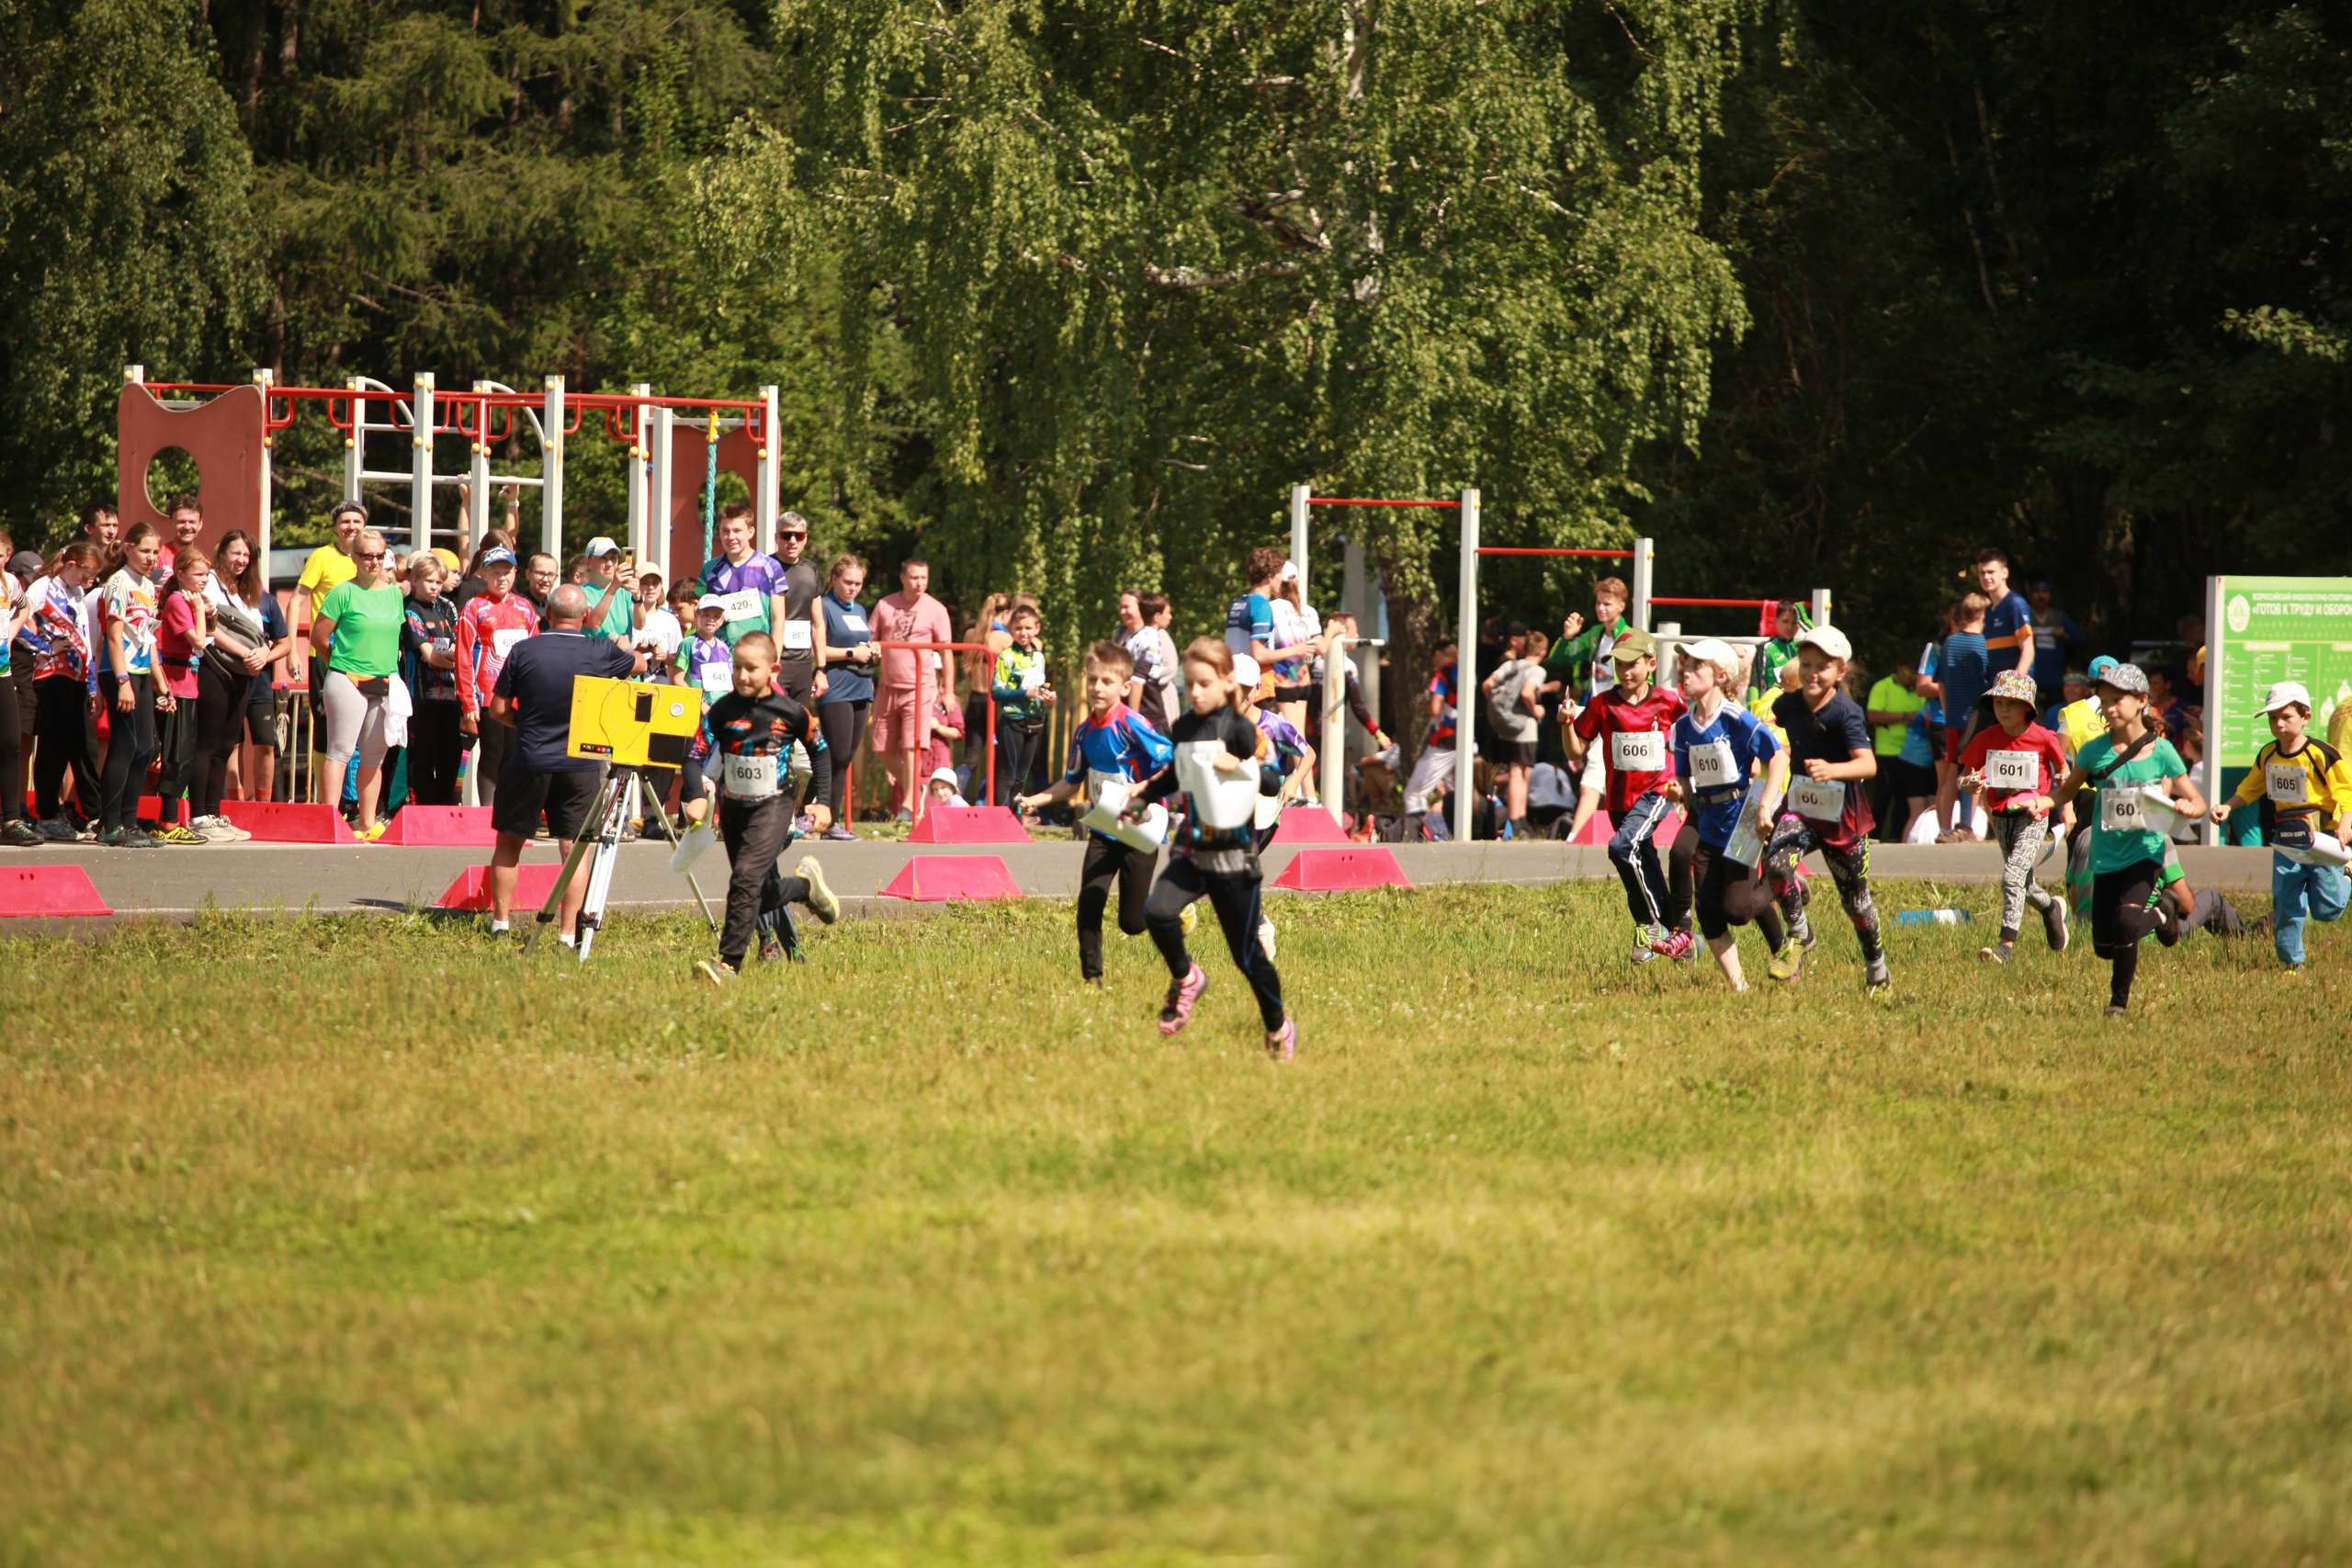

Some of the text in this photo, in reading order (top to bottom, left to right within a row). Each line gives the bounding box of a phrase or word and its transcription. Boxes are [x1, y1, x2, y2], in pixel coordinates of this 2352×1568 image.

[2282, 604, 2289, 615] К
[2290, 603, 2312, 617] ТРУДУ
[2316, 604, 2322, 615] И
[712, 673, 727, 682] 645
[1623, 744, 1648, 757] 606
[1698, 758, 1718, 772] 610
[1999, 763, 2023, 777] 601
[737, 766, 762, 780] 603
[2277, 777, 2296, 791] 605
[2116, 803, 2141, 816] 60
